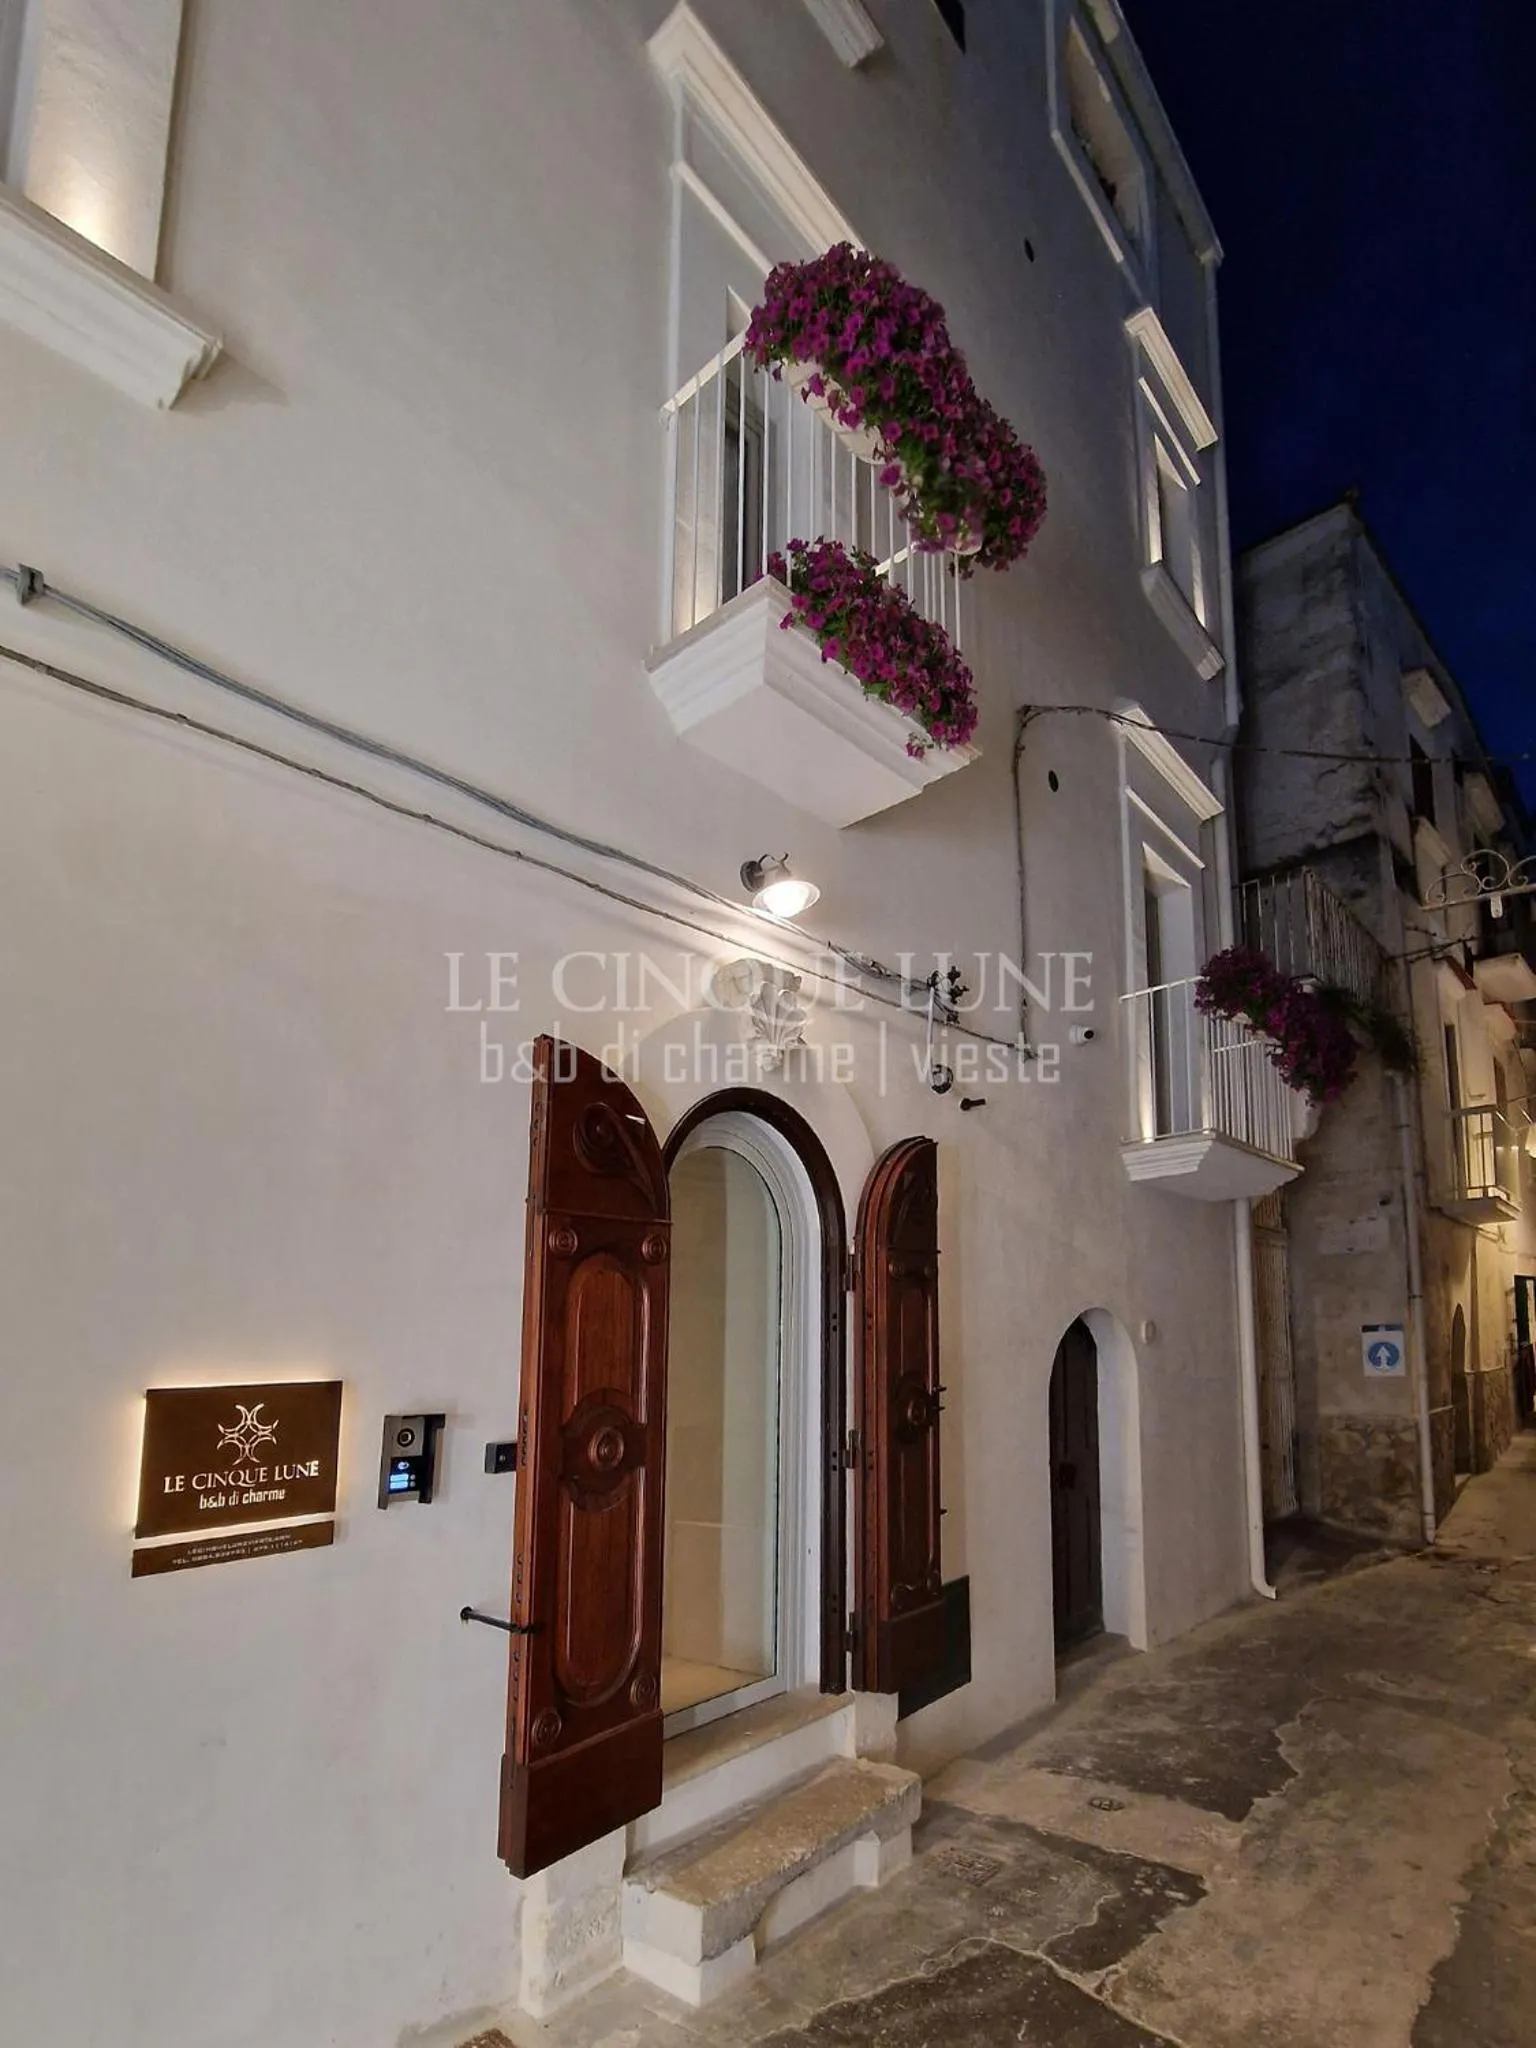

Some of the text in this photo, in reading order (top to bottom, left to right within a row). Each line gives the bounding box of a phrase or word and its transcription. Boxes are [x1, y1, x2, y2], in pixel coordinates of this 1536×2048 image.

[163, 1460, 319, 1493] LE CINQUE LUNE
[199, 1488, 286, 1510] b&b di charme
